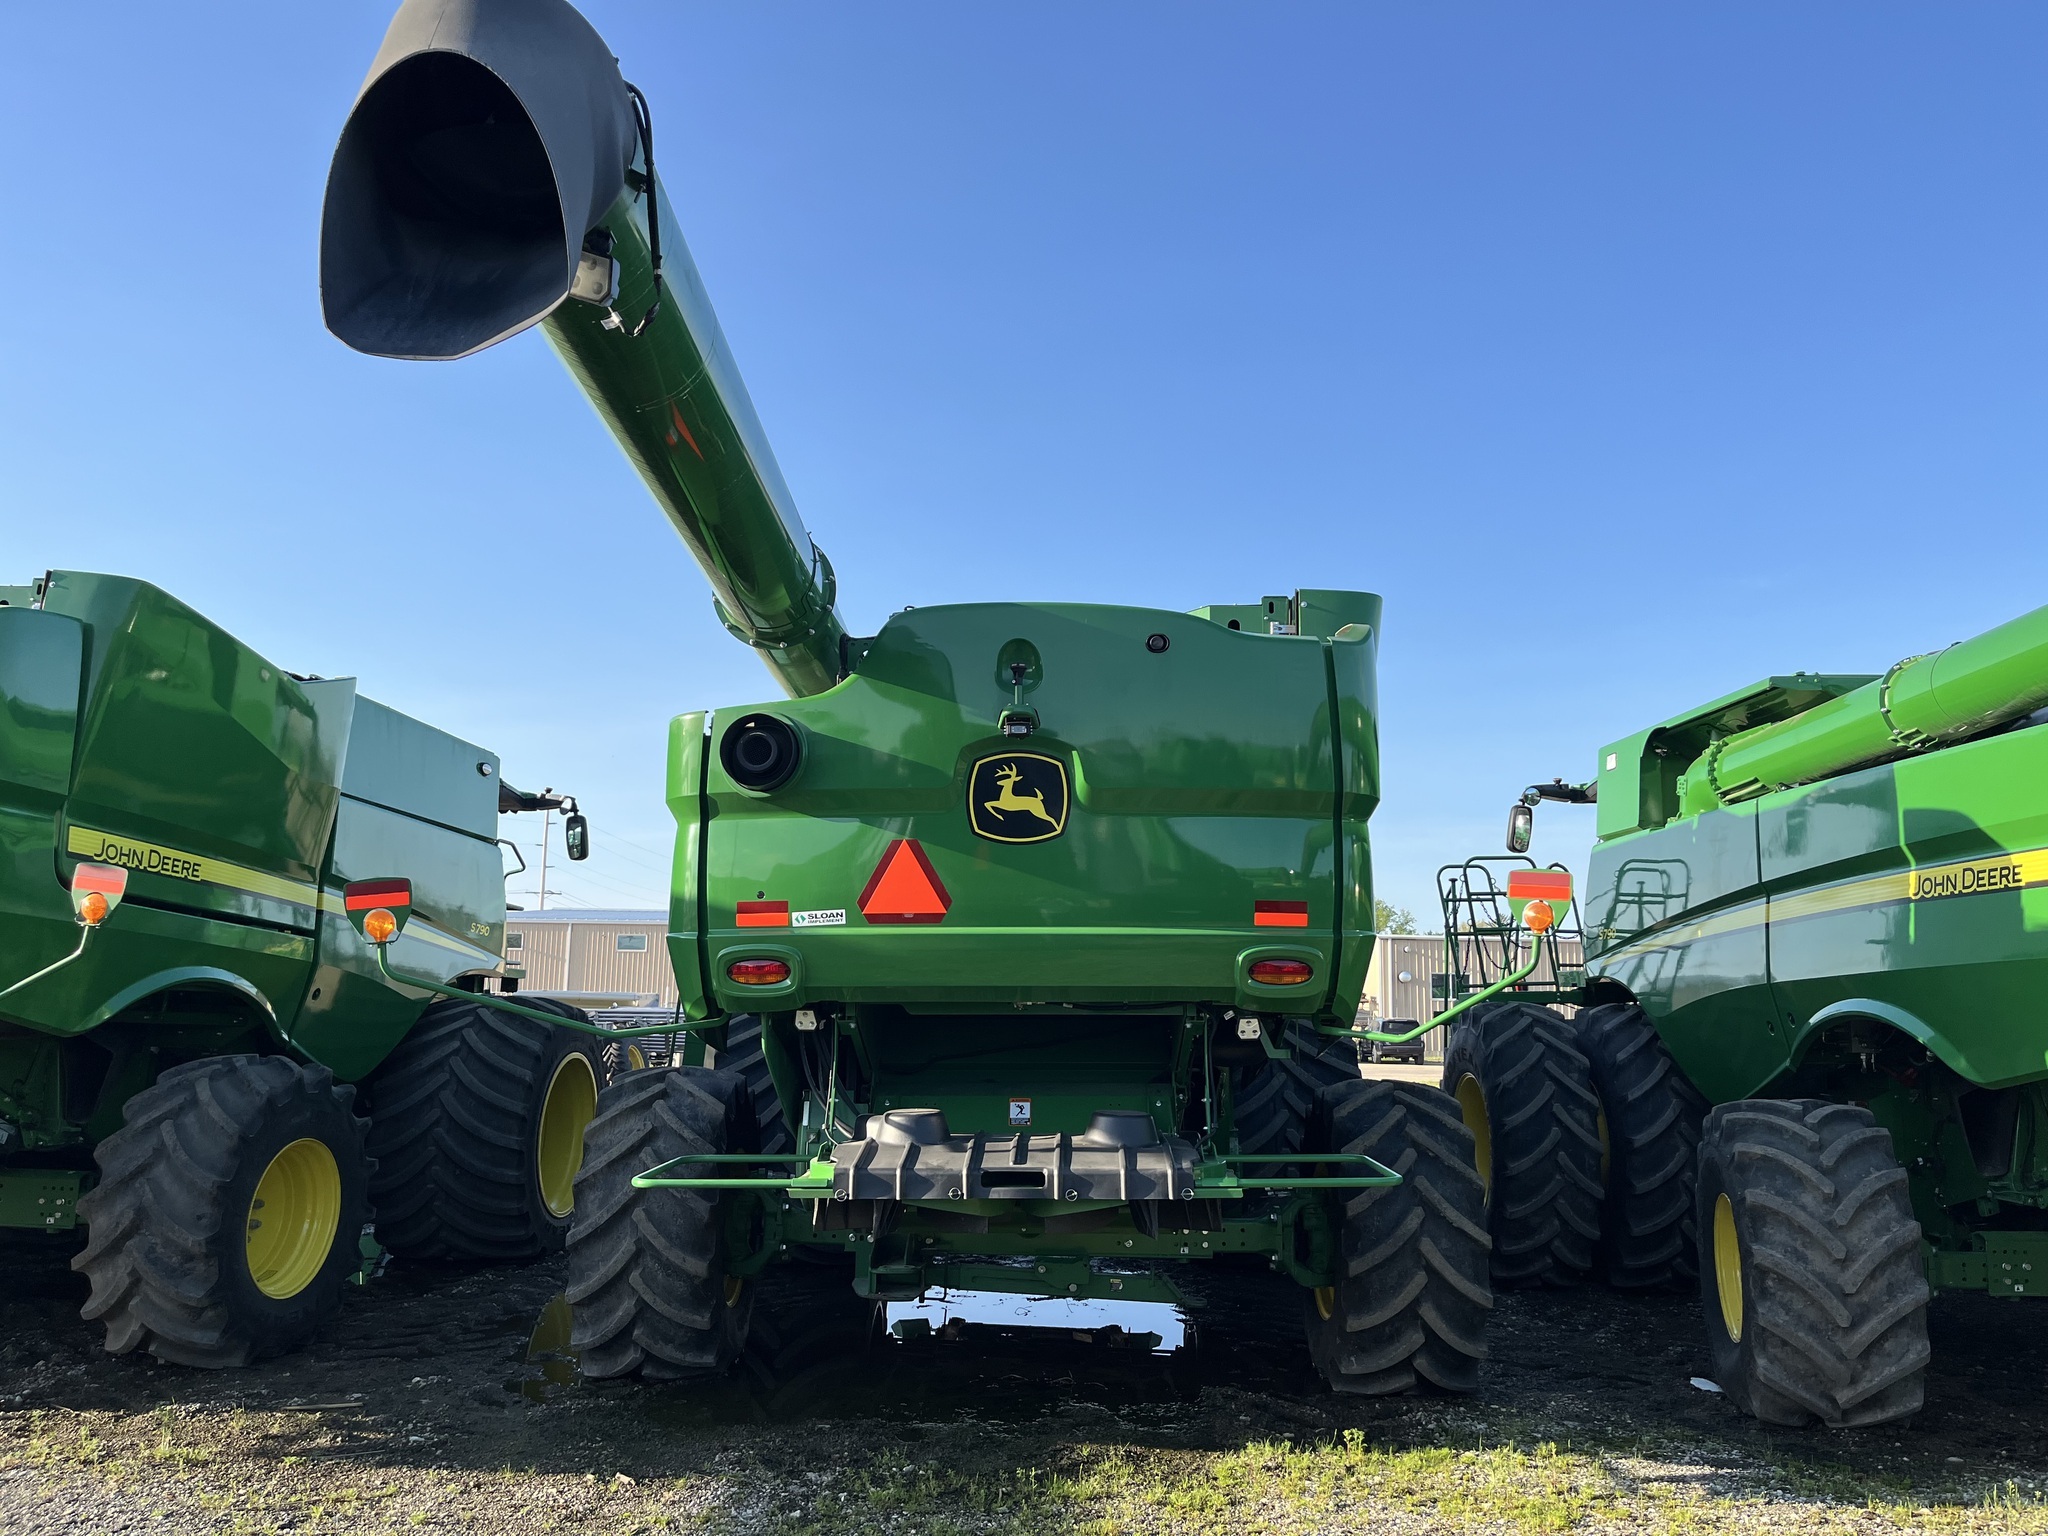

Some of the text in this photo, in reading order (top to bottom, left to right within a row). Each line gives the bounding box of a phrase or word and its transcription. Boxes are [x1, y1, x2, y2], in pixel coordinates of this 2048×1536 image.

[94, 838, 202, 879] JOHN DEERE
[1913, 864, 2023, 897] JOHN DEERE
[807, 912, 843, 920] SLOAN
[470, 922, 490, 937] S790
